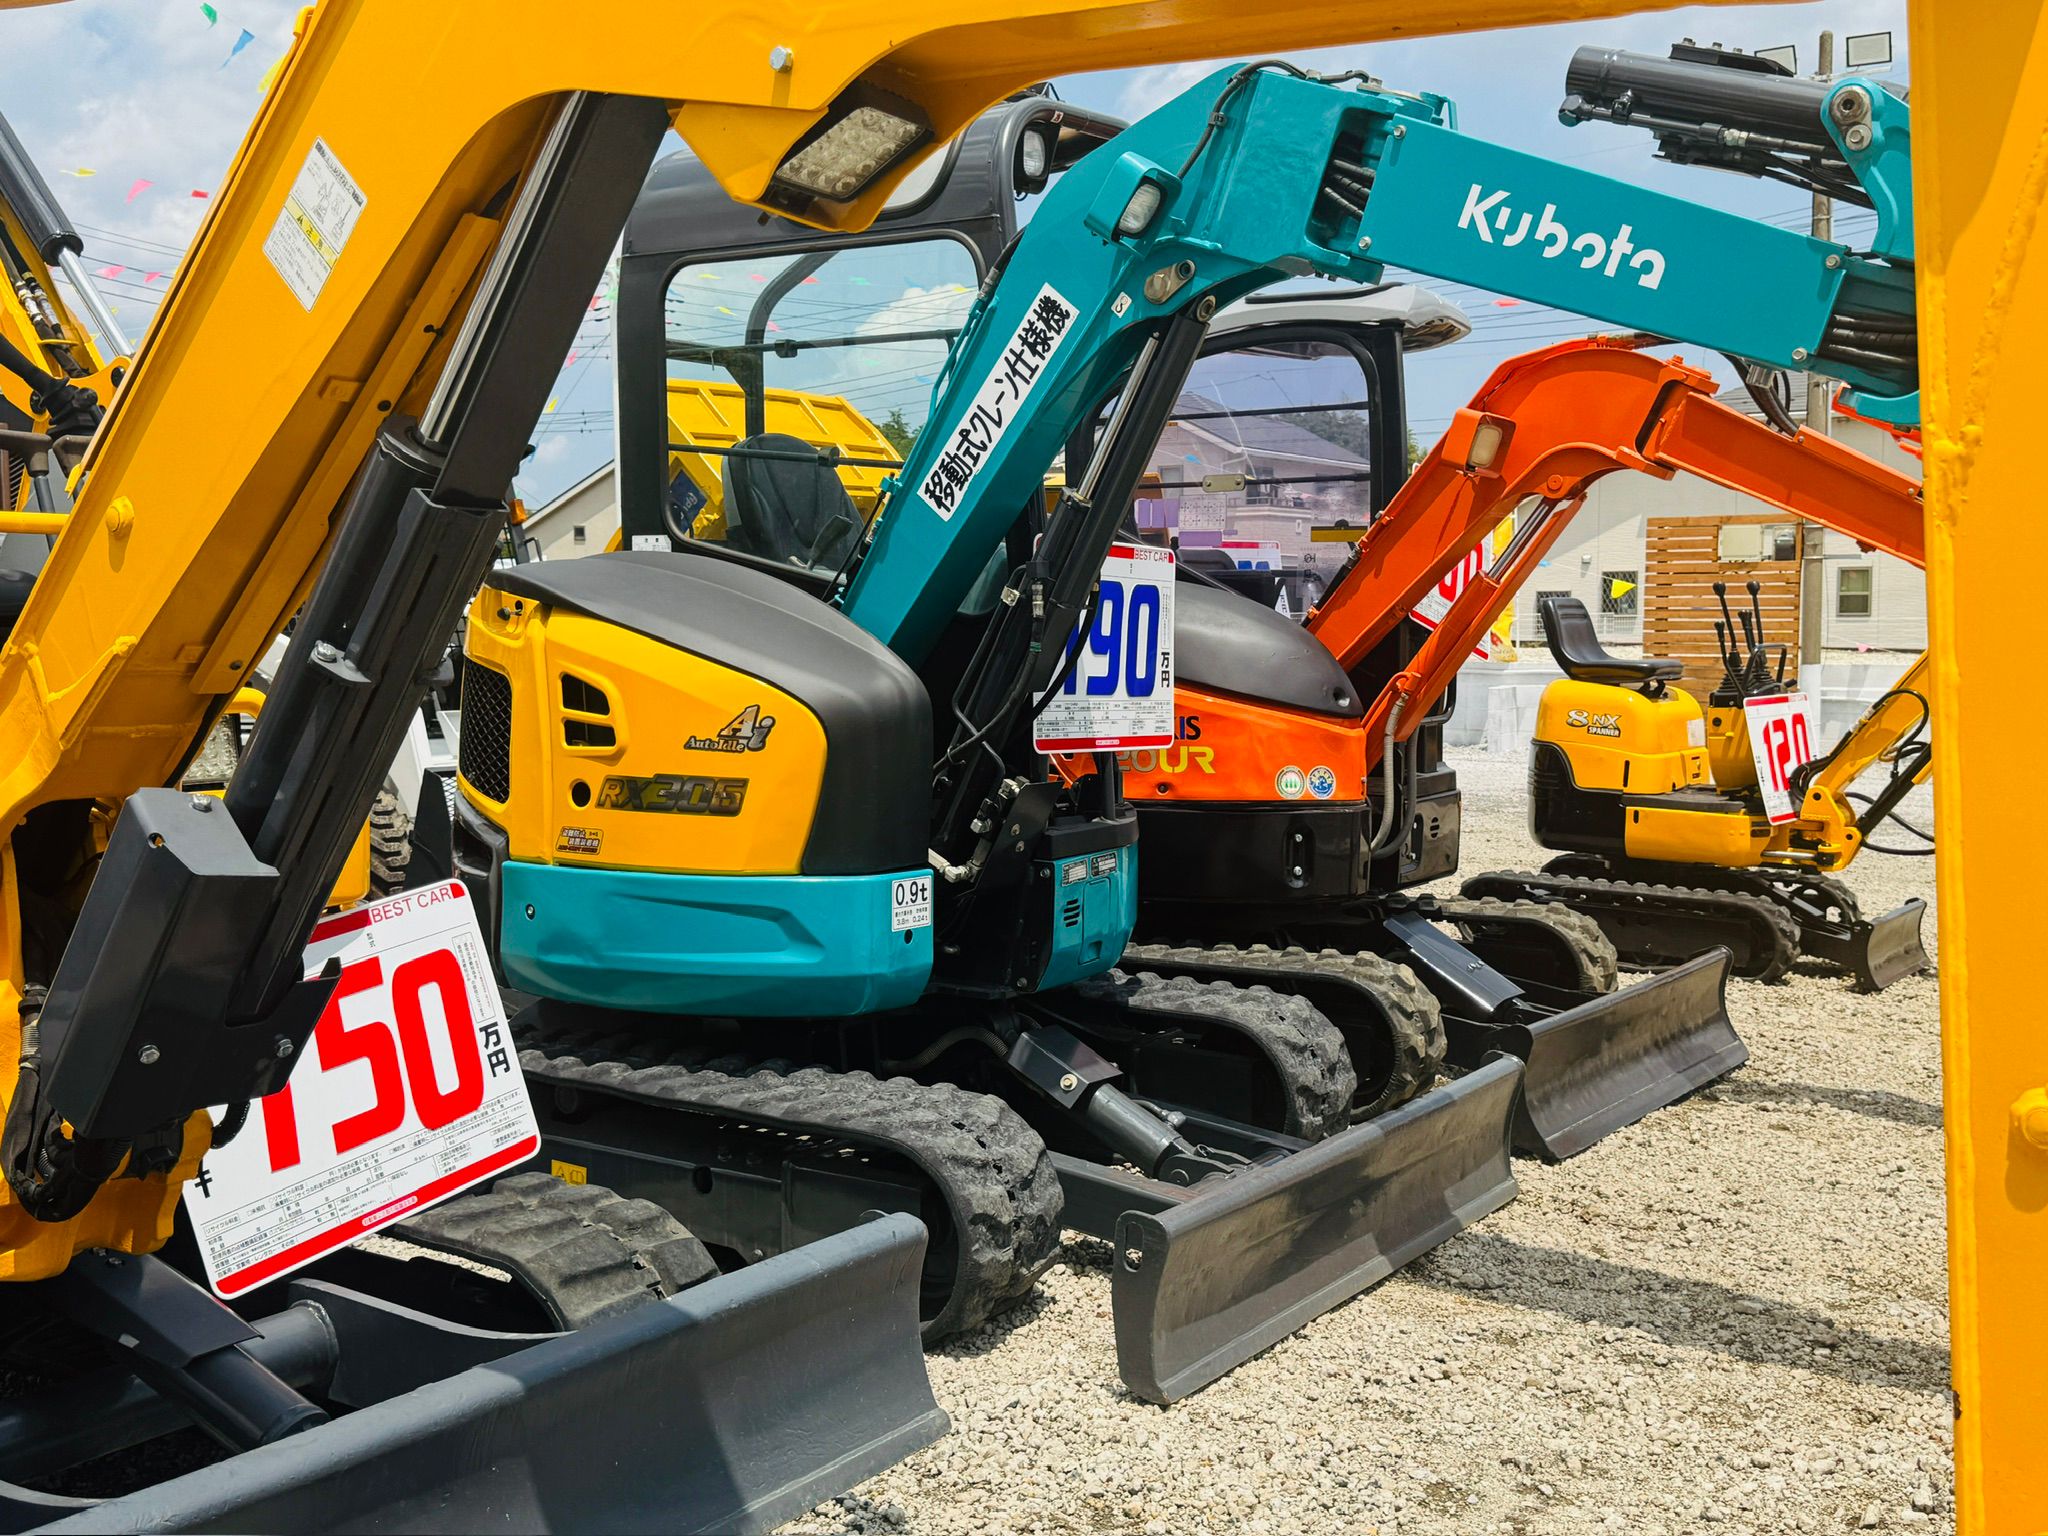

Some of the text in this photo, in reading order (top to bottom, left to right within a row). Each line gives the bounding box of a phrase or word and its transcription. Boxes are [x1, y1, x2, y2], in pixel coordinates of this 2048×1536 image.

[1457, 183, 1666, 290] Kubota
[924, 295, 1071, 513] 移動式クレーン仕様機
[1134, 549, 1168, 562] BEST CAR
[1160, 651, 1170, 688] 万円
[1174, 716, 1202, 741] IS
[1566, 709, 1622, 729] 8 NX
[1588, 726, 1621, 737] SPANNER
[1763, 713, 1811, 792] 120
[371, 887, 452, 923] BEST CAR
[895, 881, 928, 906] 0.9t
[479, 1021, 511, 1078] 万円
